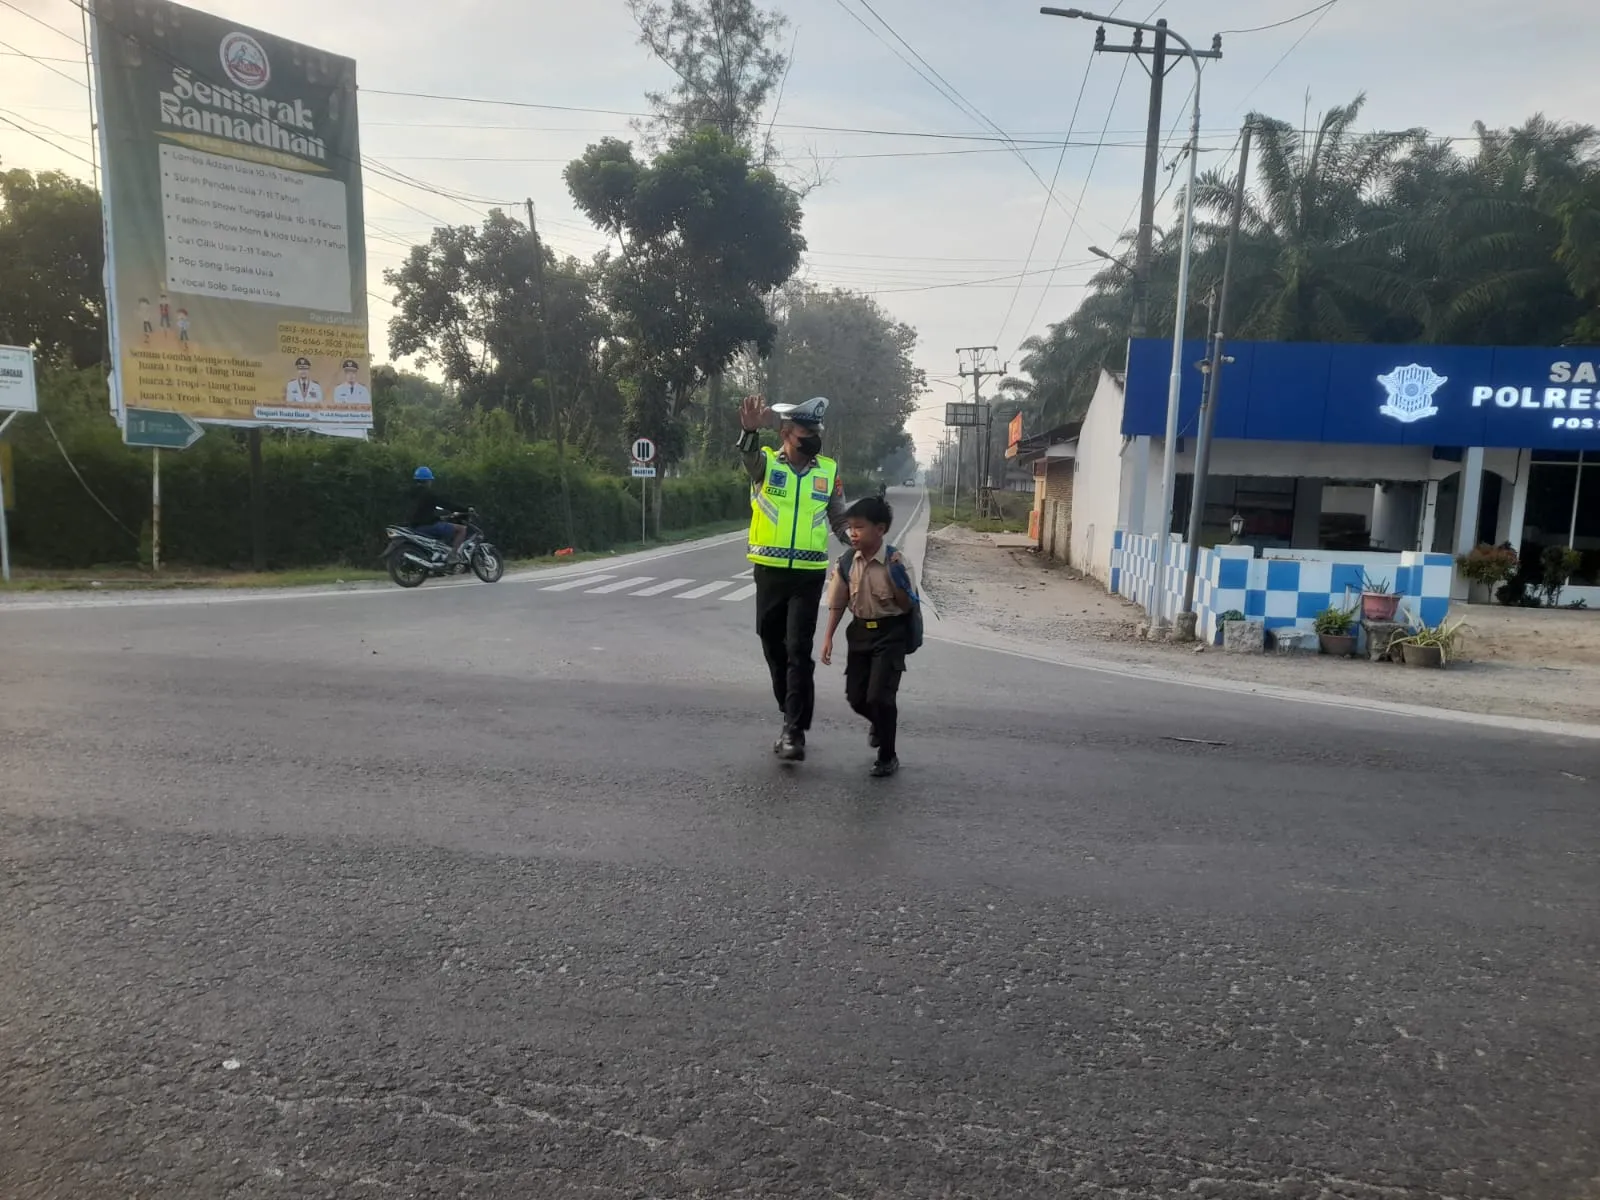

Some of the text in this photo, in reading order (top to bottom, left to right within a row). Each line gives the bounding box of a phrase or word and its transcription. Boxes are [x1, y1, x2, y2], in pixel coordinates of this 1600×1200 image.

[172, 67, 313, 130] Semarak
[159, 91, 325, 159] Ramadhan
[173, 151, 204, 166] Lomba
[206, 158, 234, 171] Adzan
[235, 165, 254, 176] Usia
[279, 173, 304, 186] Tahun
[174, 172, 201, 184] Surah
[202, 177, 236, 191] Pendek
[238, 185, 256, 196] Usia
[274, 191, 301, 204] Tahun
[175, 193, 211, 207] Fashion
[213, 201, 236, 212] Show
[239, 204, 273, 220] Tunggal
[275, 211, 293, 222] Usia
[318, 219, 342, 231] Tahun
[176, 215, 212, 228] Fashion
[213, 221, 238, 233] Show
[240, 225, 262, 237] Mom
[271, 231, 289, 242] Kids
[290, 234, 308, 244] Usia
[323, 239, 346, 250] Tahun
[196, 238, 217, 249] Cilik
[218, 242, 237, 253] Usia
[256, 247, 283, 259] Tahun
[178, 256, 274, 278] Pop Song Segala Usia
[180, 279, 281, 298] Vocal Solo Segala Usia
[162, 352, 192, 362] Lomba
[138, 361, 165, 372] Juara
[174, 364, 198, 375] Tropi
[206, 366, 230, 377] Uang
[231, 368, 255, 378] Tunai
[1549, 361, 1600, 383] SA
[138, 375, 165, 386] Juara
[176, 378, 200, 390] Tropi
[208, 380, 231, 392] Uang
[232, 382, 256, 392] Tunai
[140, 391, 165, 401] Juara
[176, 393, 200, 405] Tropi
[208, 395, 231, 406] Uang
[1552, 417, 1594, 429] POS
